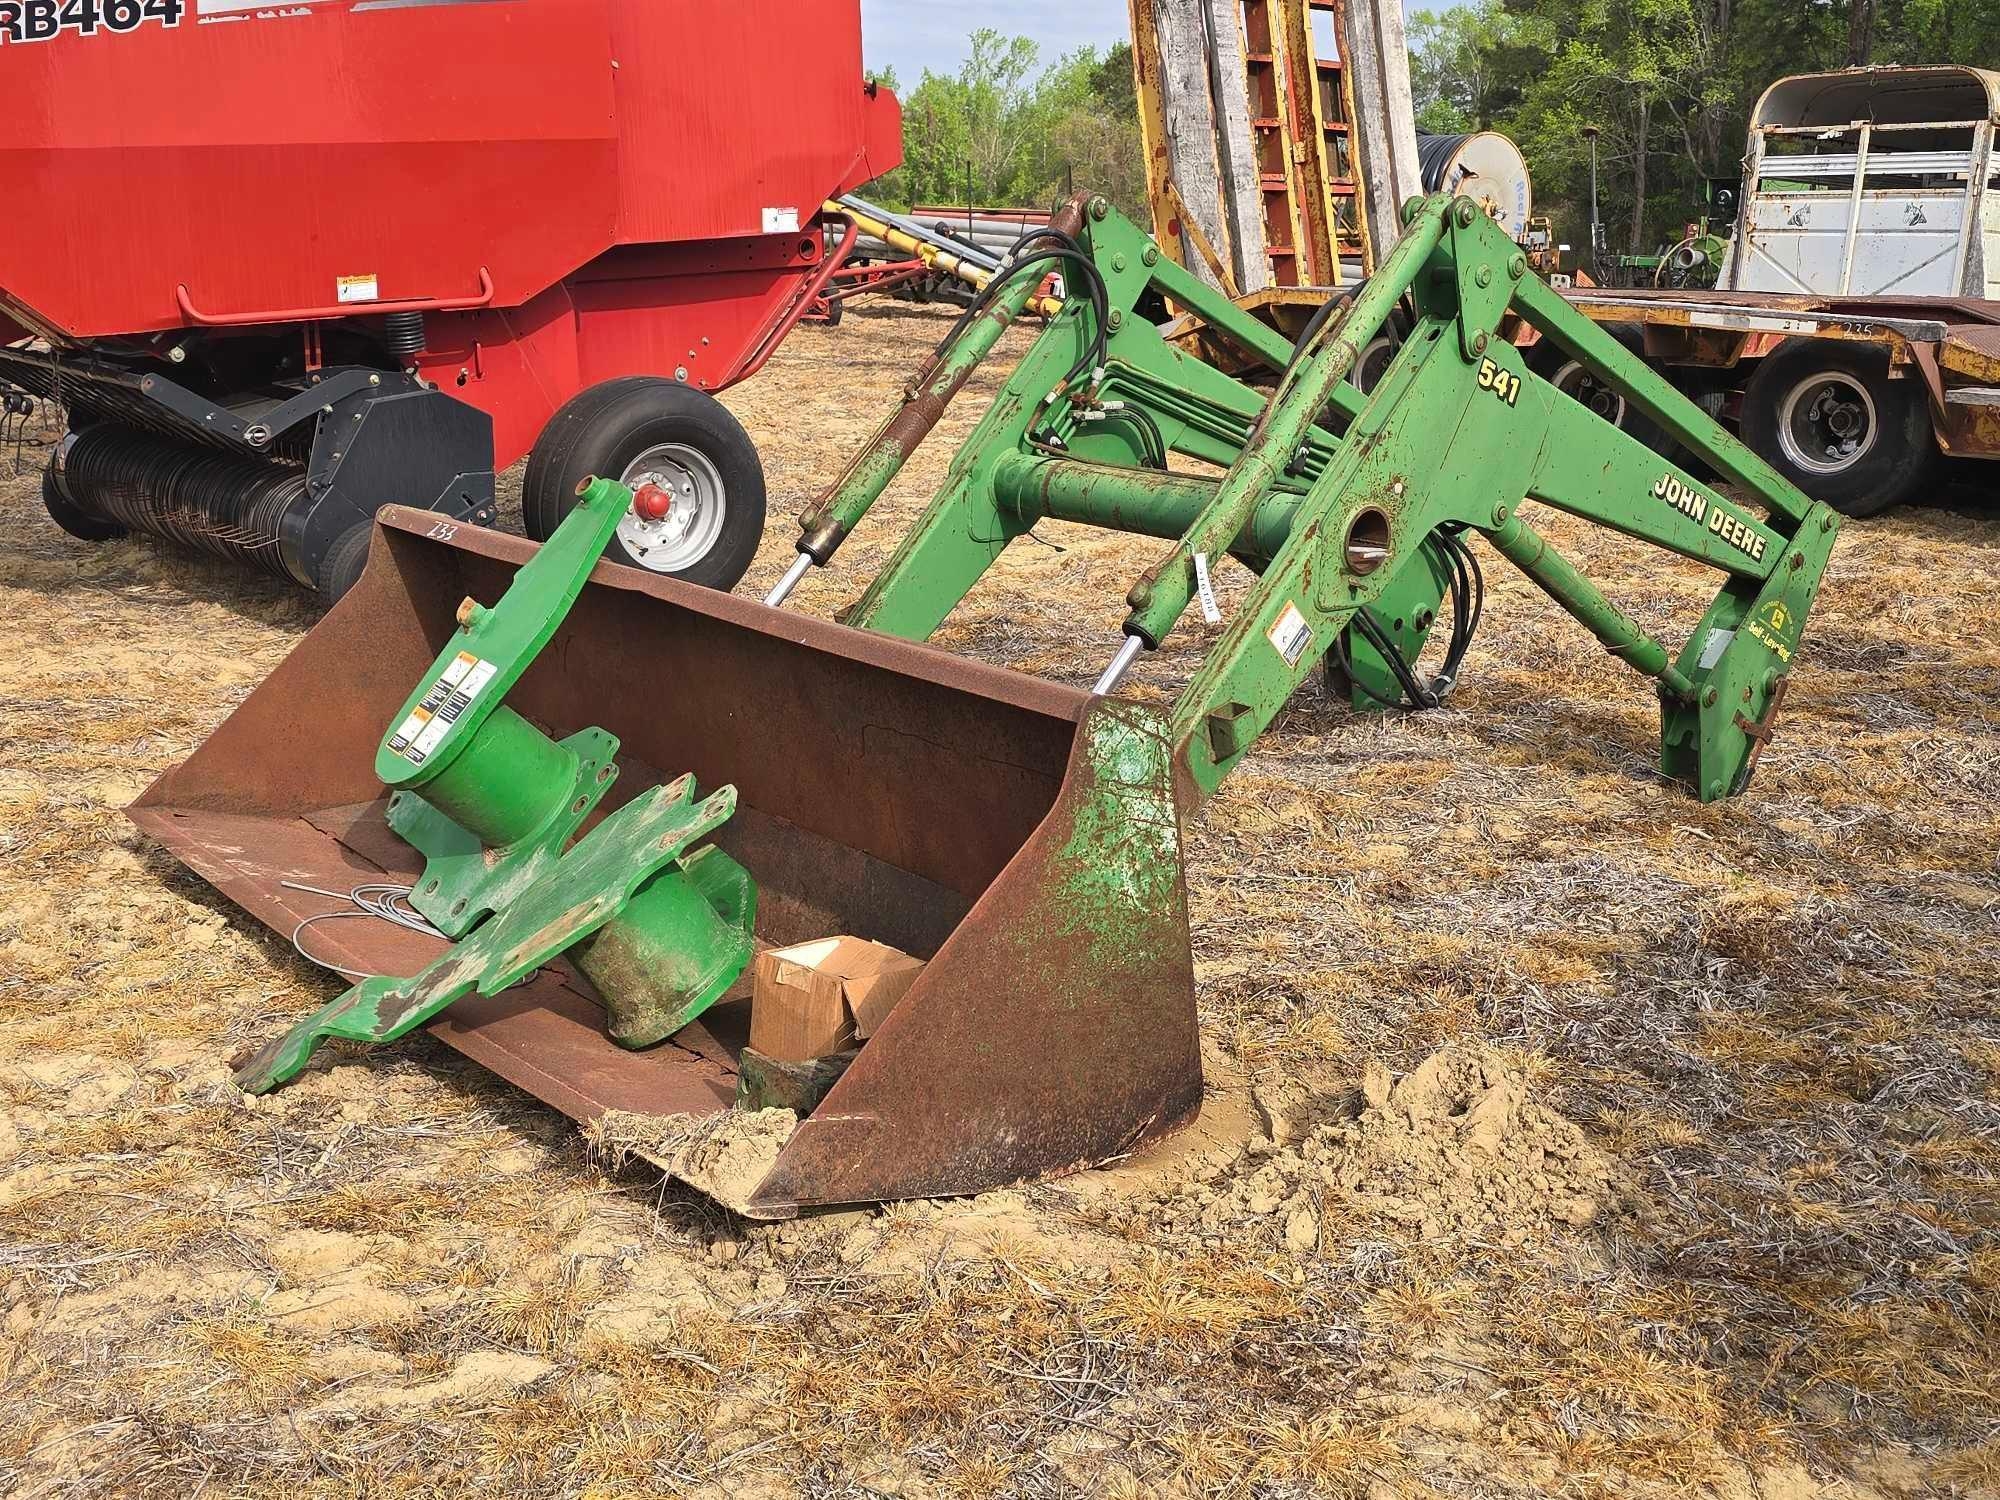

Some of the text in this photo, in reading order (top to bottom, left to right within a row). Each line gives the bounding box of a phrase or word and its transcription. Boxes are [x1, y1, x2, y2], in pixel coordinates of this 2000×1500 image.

[1478, 355, 1521, 408] 541
[1654, 473, 1768, 563] JOHN DEERE
